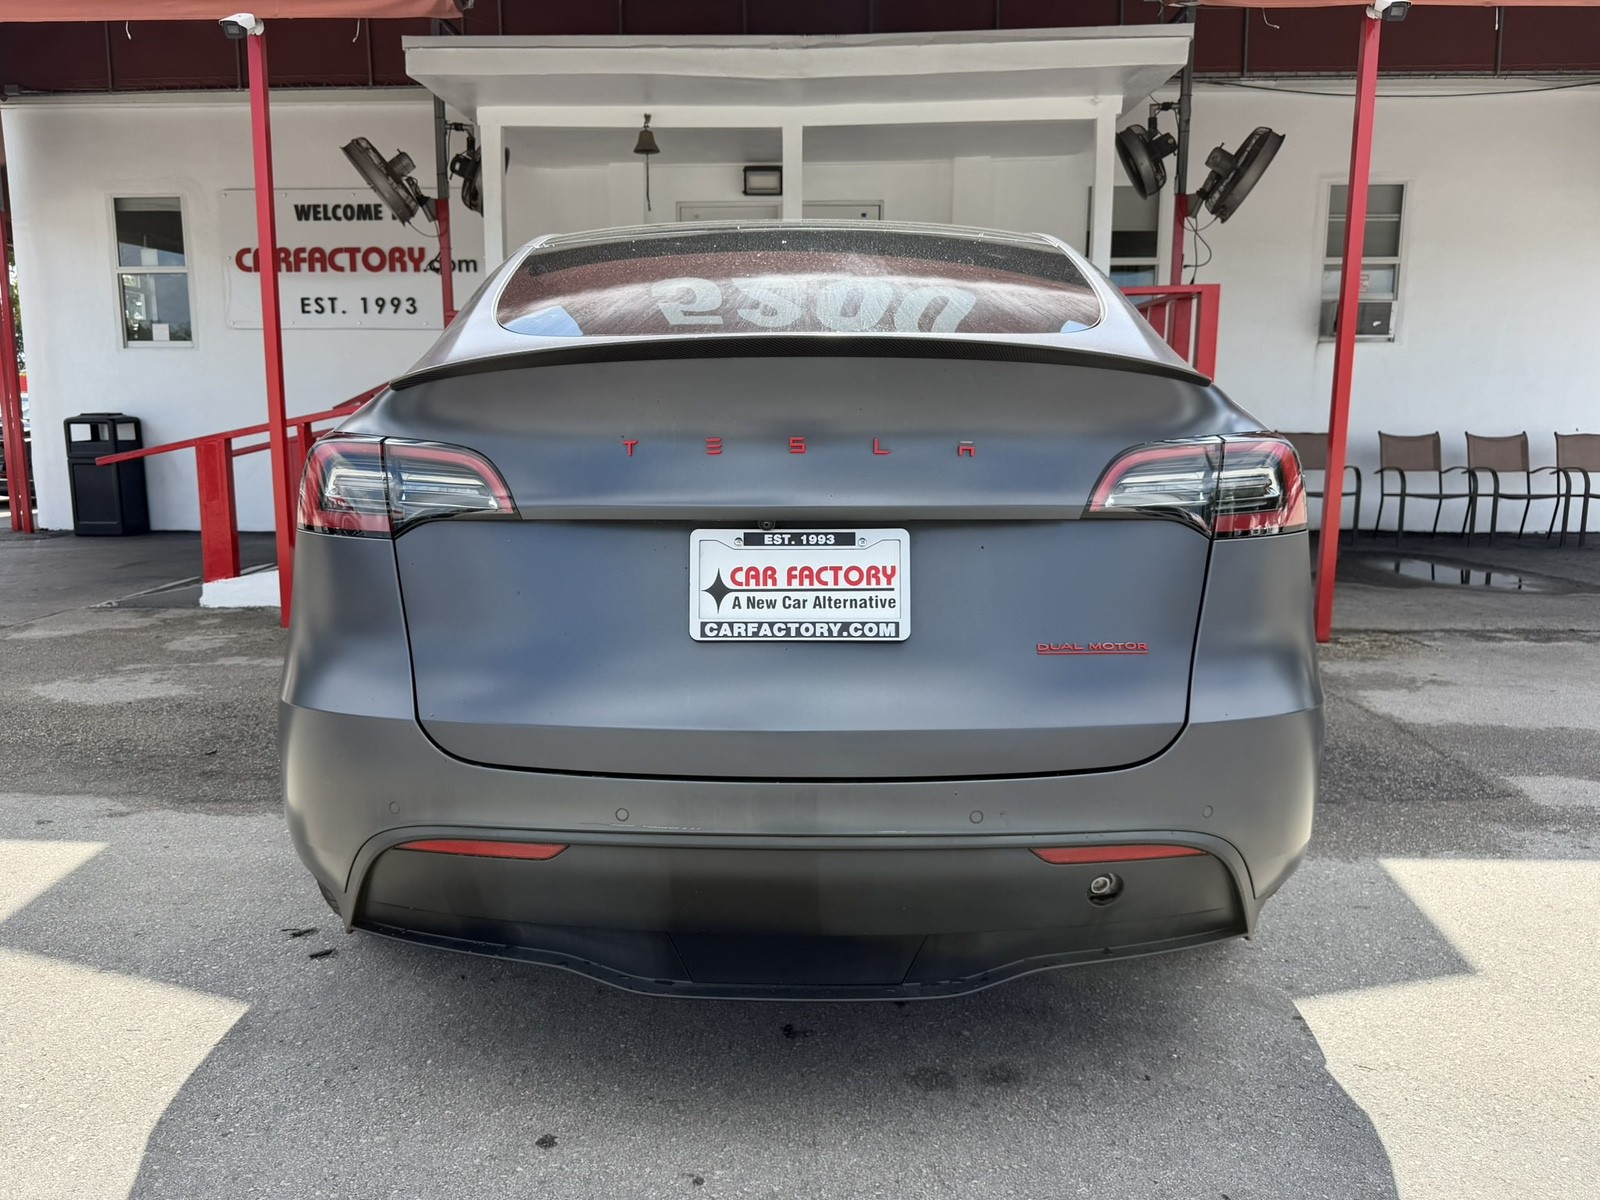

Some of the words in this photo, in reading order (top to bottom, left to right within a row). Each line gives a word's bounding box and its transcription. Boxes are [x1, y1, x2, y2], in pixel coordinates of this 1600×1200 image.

[294, 203, 382, 221] WELCOME
[301, 297, 347, 315] EST.
[361, 297, 418, 315] 1993
[622, 436, 976, 457] TESLA
[764, 534, 796, 545] EST.
[800, 534, 836, 545] 1993
[730, 566, 777, 587] CAR
[786, 565, 896, 586] FACTORY
[732, 596, 742, 610] A
[747, 596, 777, 609] New
[782, 596, 808, 609] Car
[813, 595, 897, 609] Alternative
[704, 622, 896, 637] CARFACTORY.COM
[1037, 642, 1085, 651] DUAL
[1088, 641, 1148, 650] MOTOR
